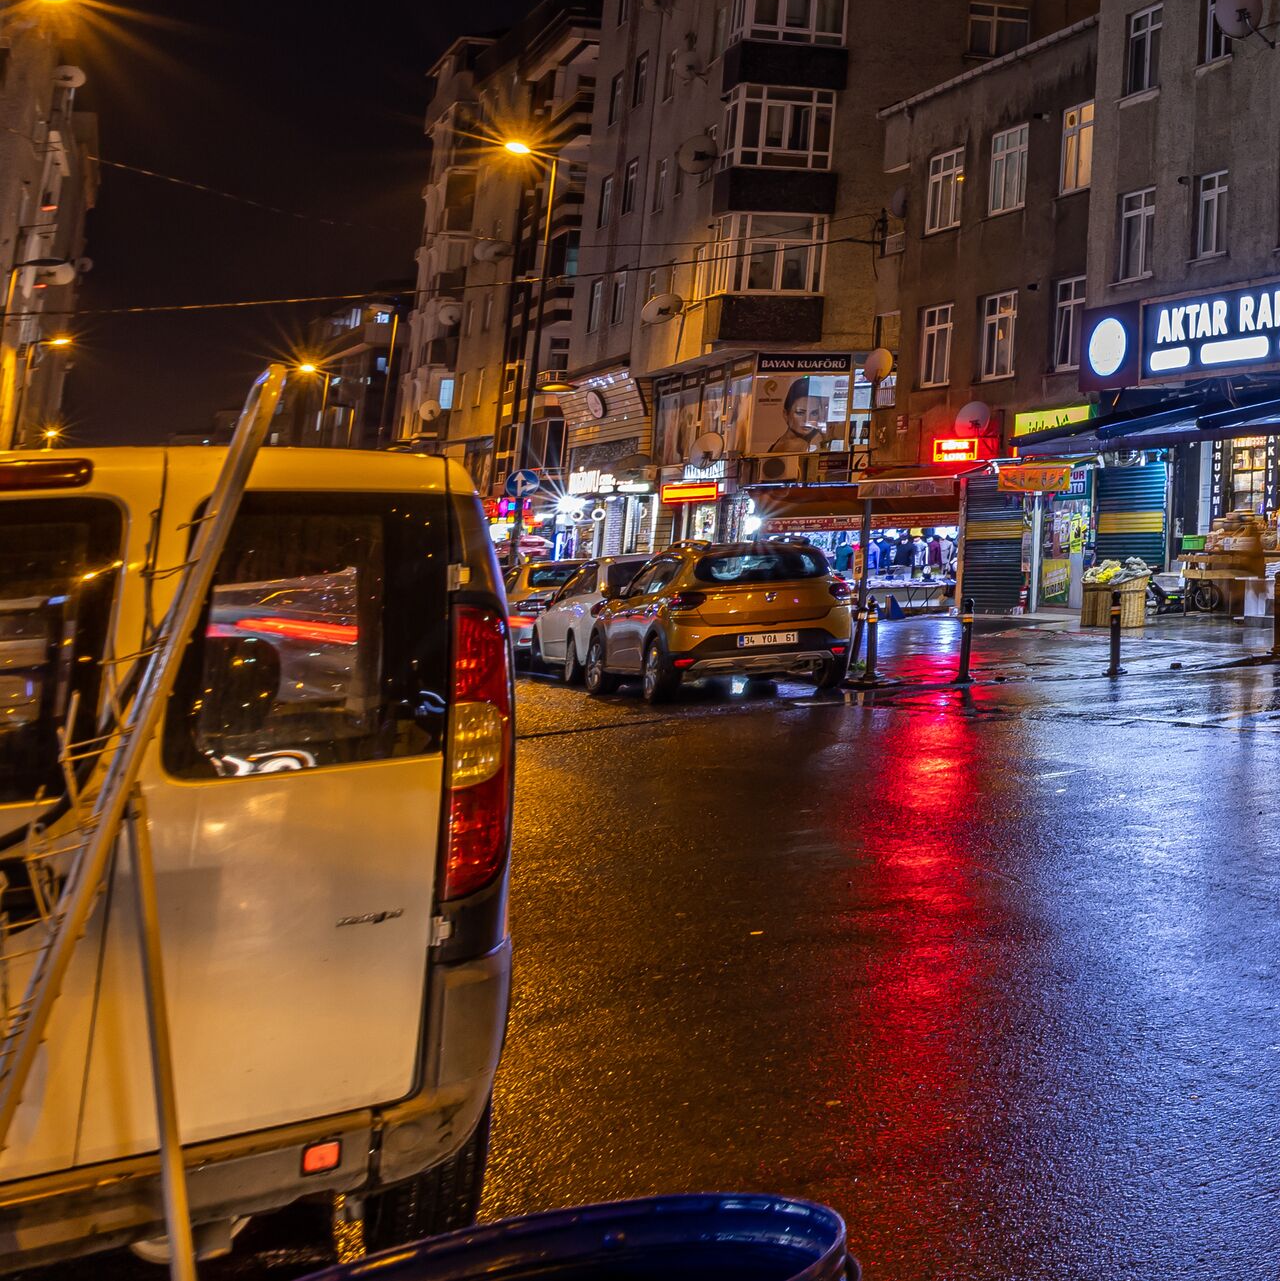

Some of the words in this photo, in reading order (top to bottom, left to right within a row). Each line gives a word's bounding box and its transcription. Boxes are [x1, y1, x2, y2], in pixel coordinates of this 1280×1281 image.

[1155, 300, 1228, 344] AKTAR
[761, 358, 795, 369] BAYAN
[797, 357, 847, 369] KUAFÖRÜ
[1212, 440, 1222, 516] URUYEMİ
[1265, 434, 1276, 522] AKLİYAT
[744, 636, 755, 645] 34
[761, 634, 778, 644] YOA
